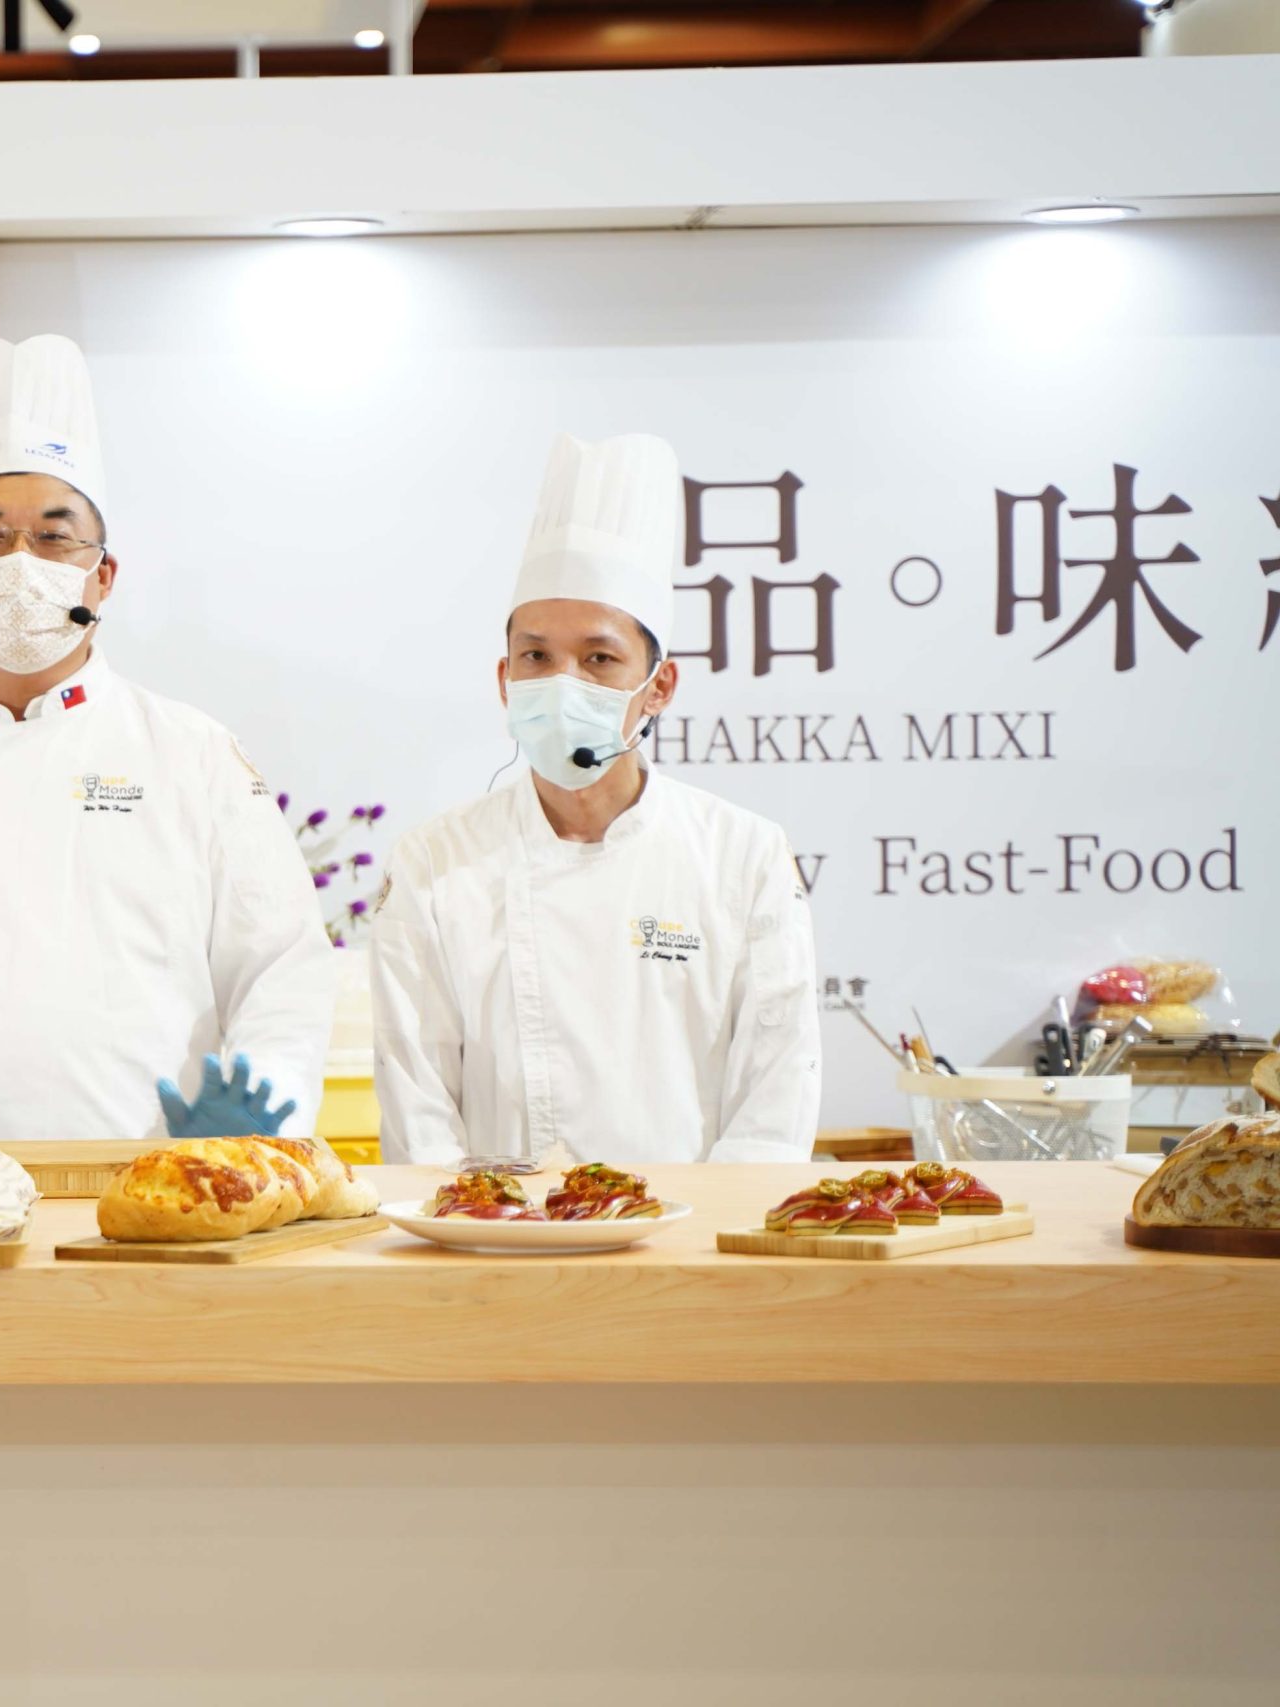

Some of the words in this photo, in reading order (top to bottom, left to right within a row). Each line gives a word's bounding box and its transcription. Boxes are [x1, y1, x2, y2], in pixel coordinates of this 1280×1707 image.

[652, 714, 882, 764] HAKKA
[902, 711, 1057, 762] MIXI
[99, 784, 144, 795] Monde
[873, 827, 1244, 896] Fast-Food
[656, 930, 701, 944] Monde
[817, 976, 870, 997] 員會
